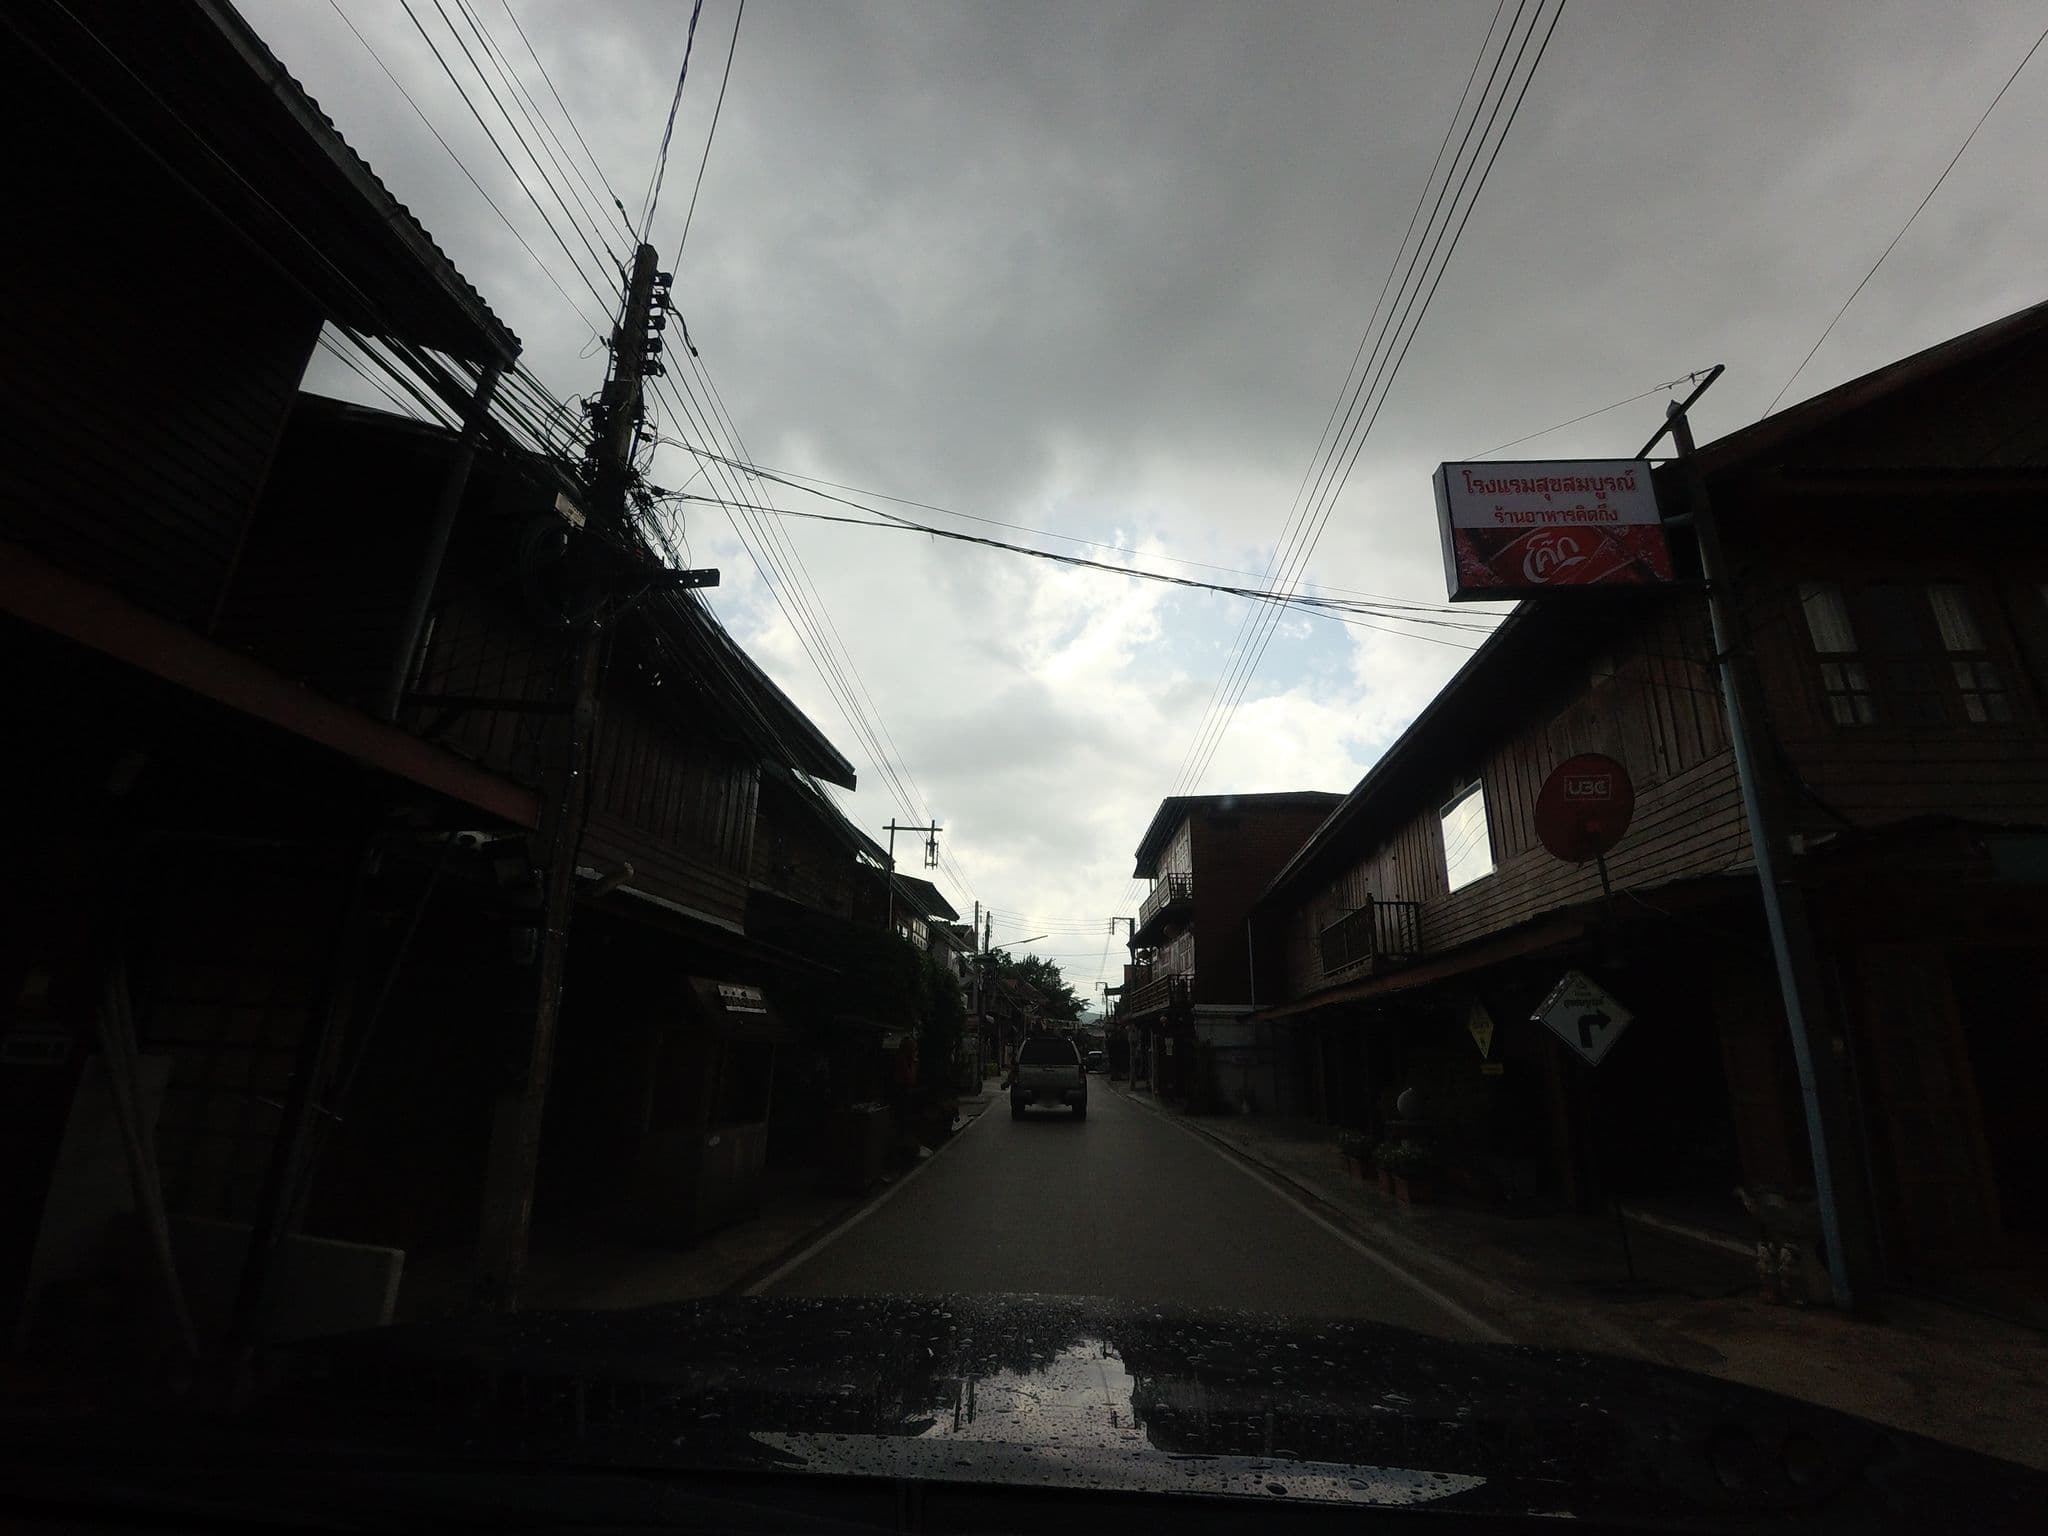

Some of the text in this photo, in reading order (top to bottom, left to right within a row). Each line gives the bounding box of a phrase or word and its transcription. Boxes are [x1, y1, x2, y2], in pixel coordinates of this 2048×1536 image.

[1462, 469, 1636, 501] โรงแรมสุขสมบูรณ์
[1494, 504, 1618, 524] ร้านอาหารคิดถึง
